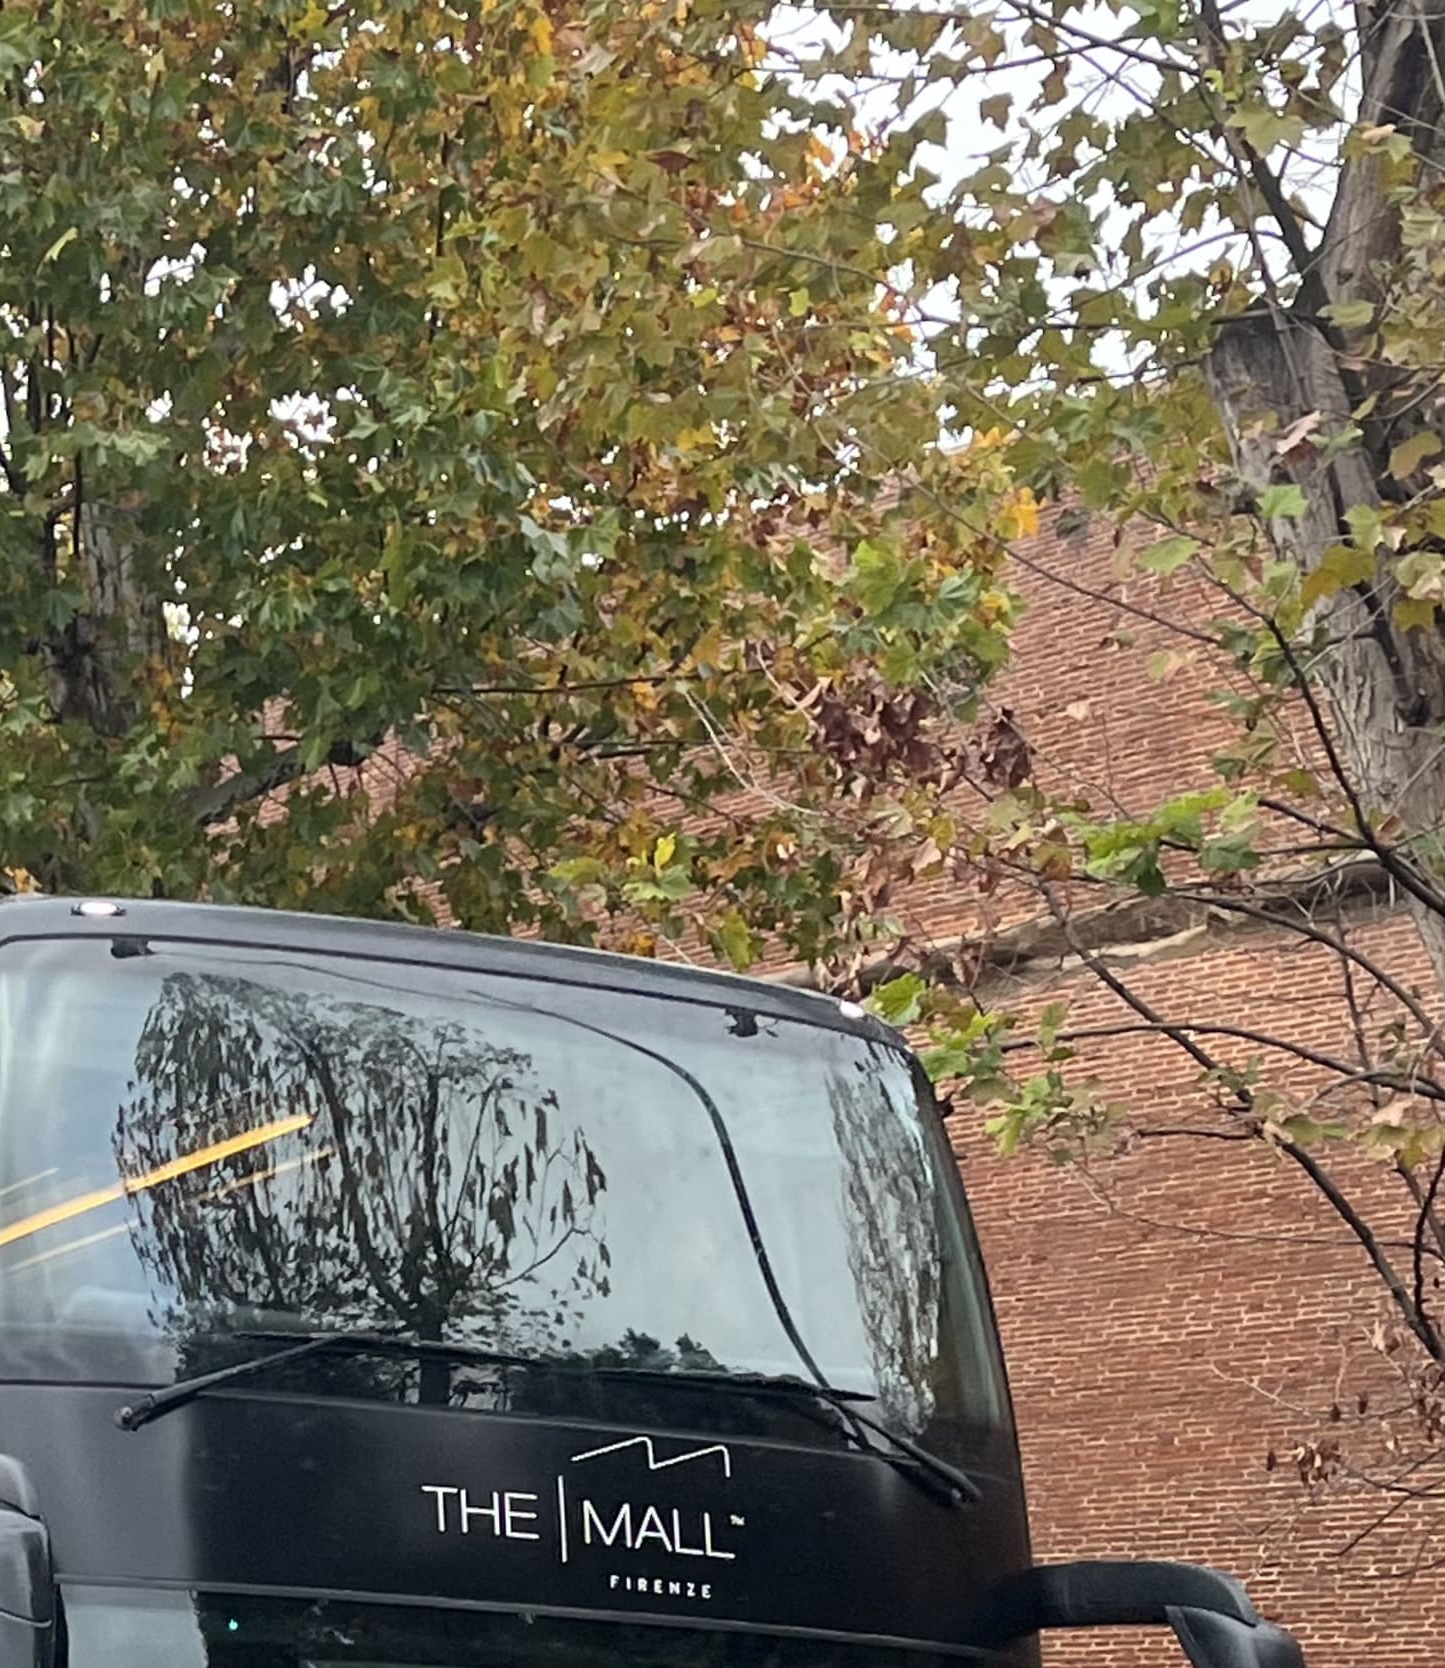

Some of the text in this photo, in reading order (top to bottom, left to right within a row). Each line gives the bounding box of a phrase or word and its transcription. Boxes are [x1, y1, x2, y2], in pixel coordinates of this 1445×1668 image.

[421, 1485, 540, 1540] THE
[582, 1499, 736, 1560] MALL
[609, 1574, 713, 1600] FIRENZE
